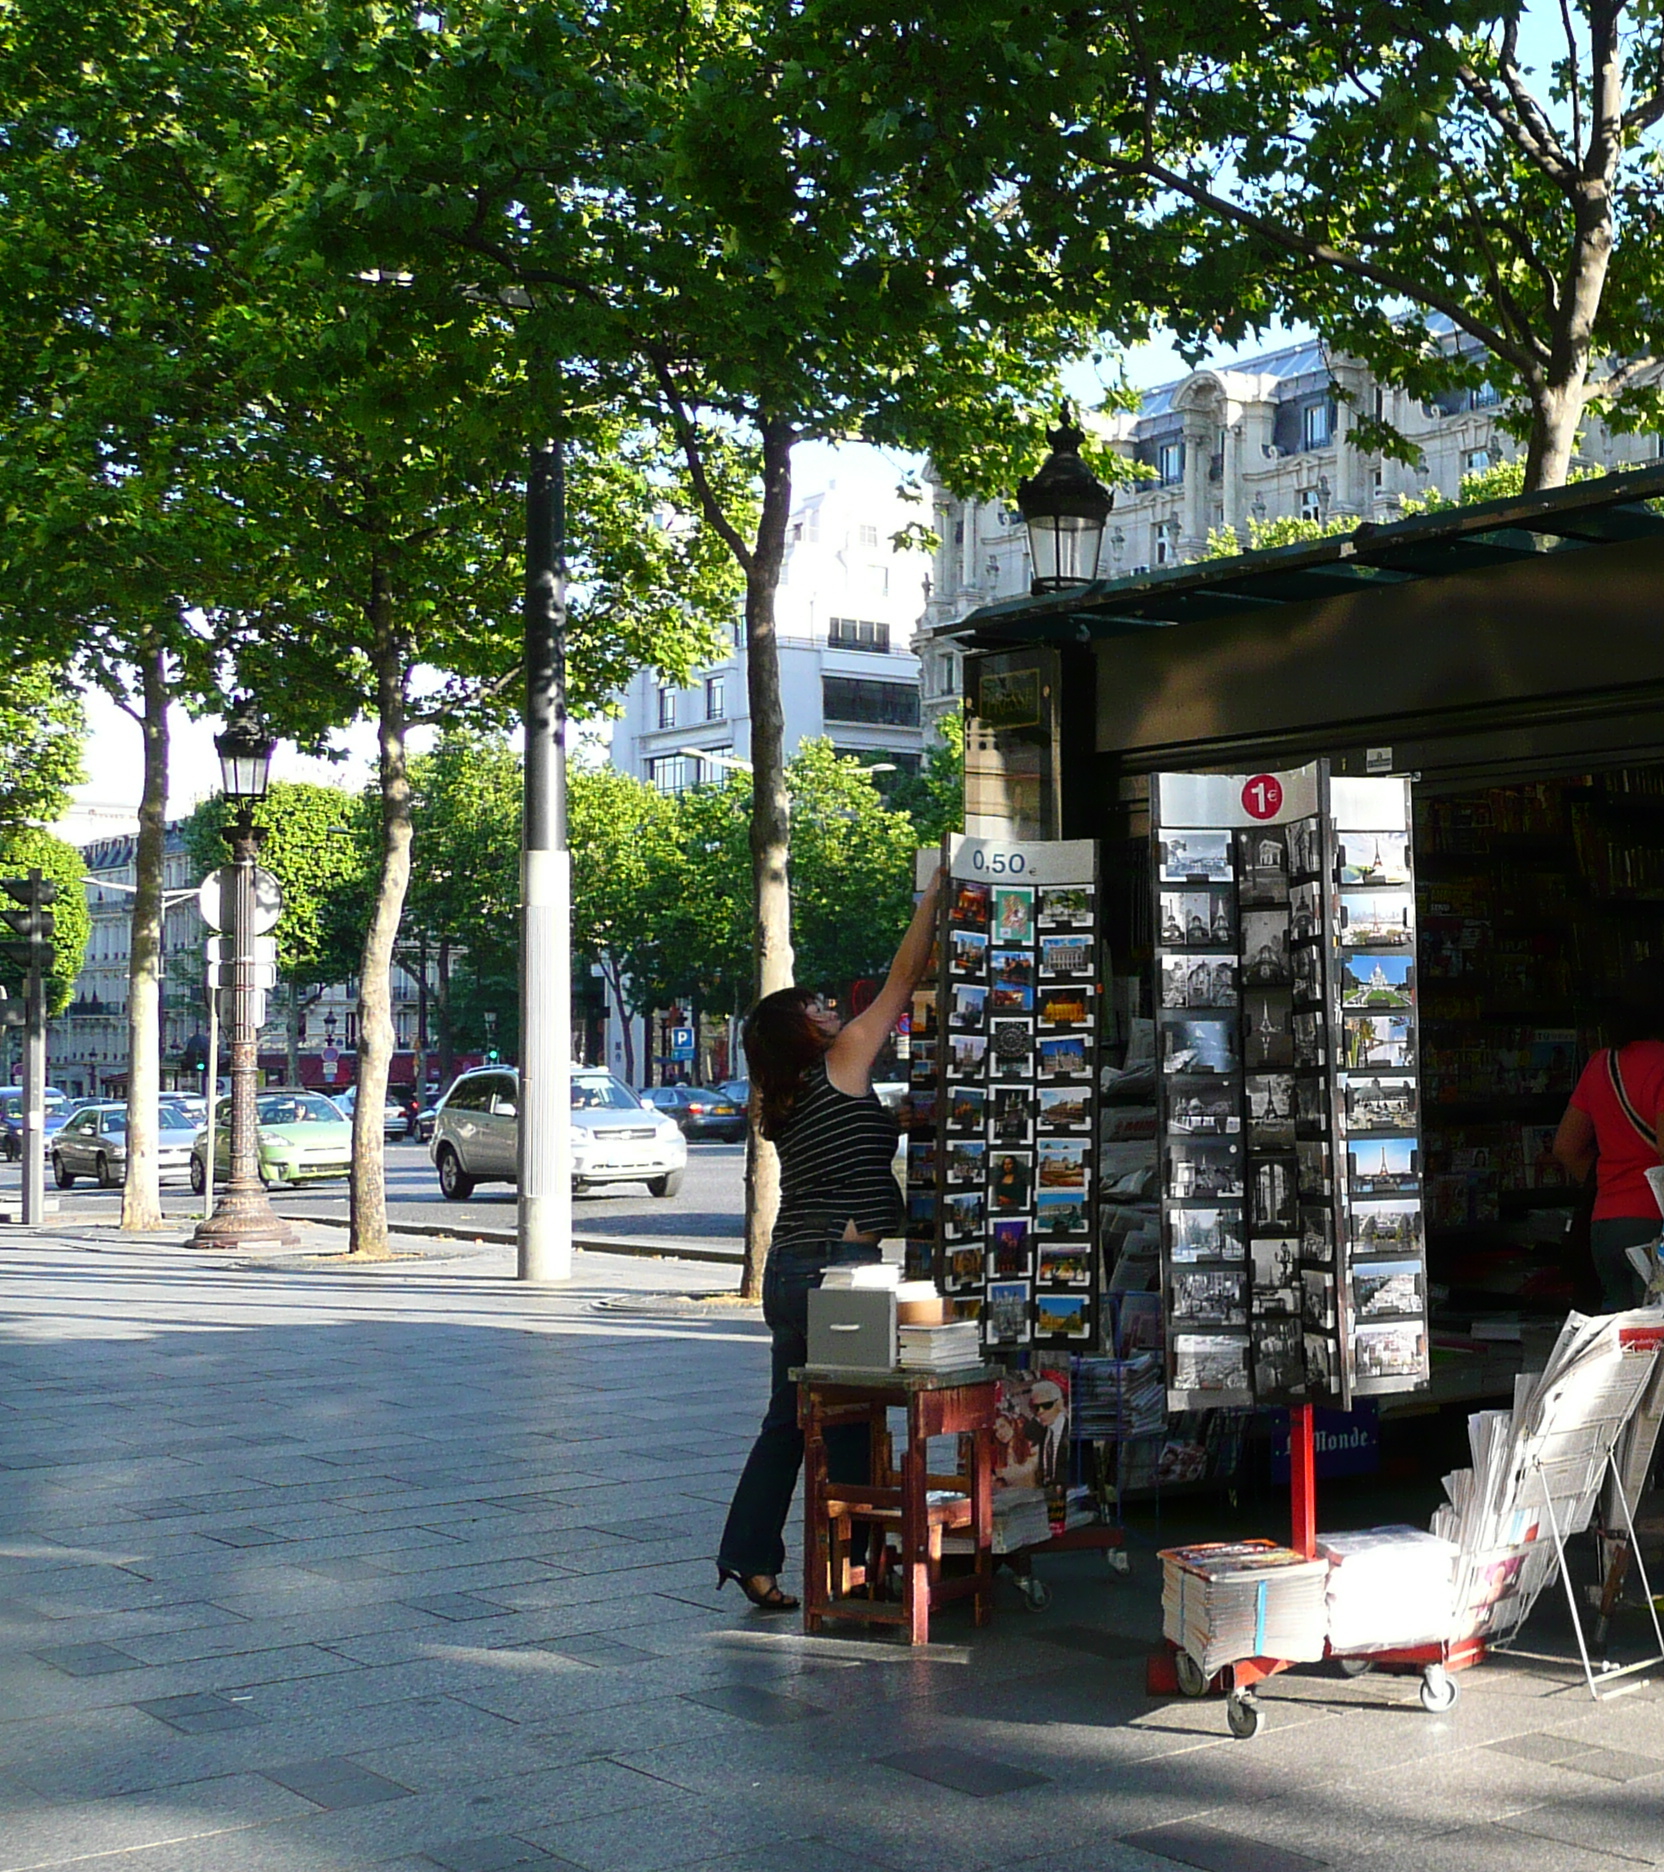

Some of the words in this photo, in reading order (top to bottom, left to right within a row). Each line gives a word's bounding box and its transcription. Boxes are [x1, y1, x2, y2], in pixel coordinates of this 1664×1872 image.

[1251, 783, 1265, 812] 1
[1267, 789, 1277, 801] €
[973, 850, 1025, 873] 0,50
[678, 1031, 688, 1045] P
